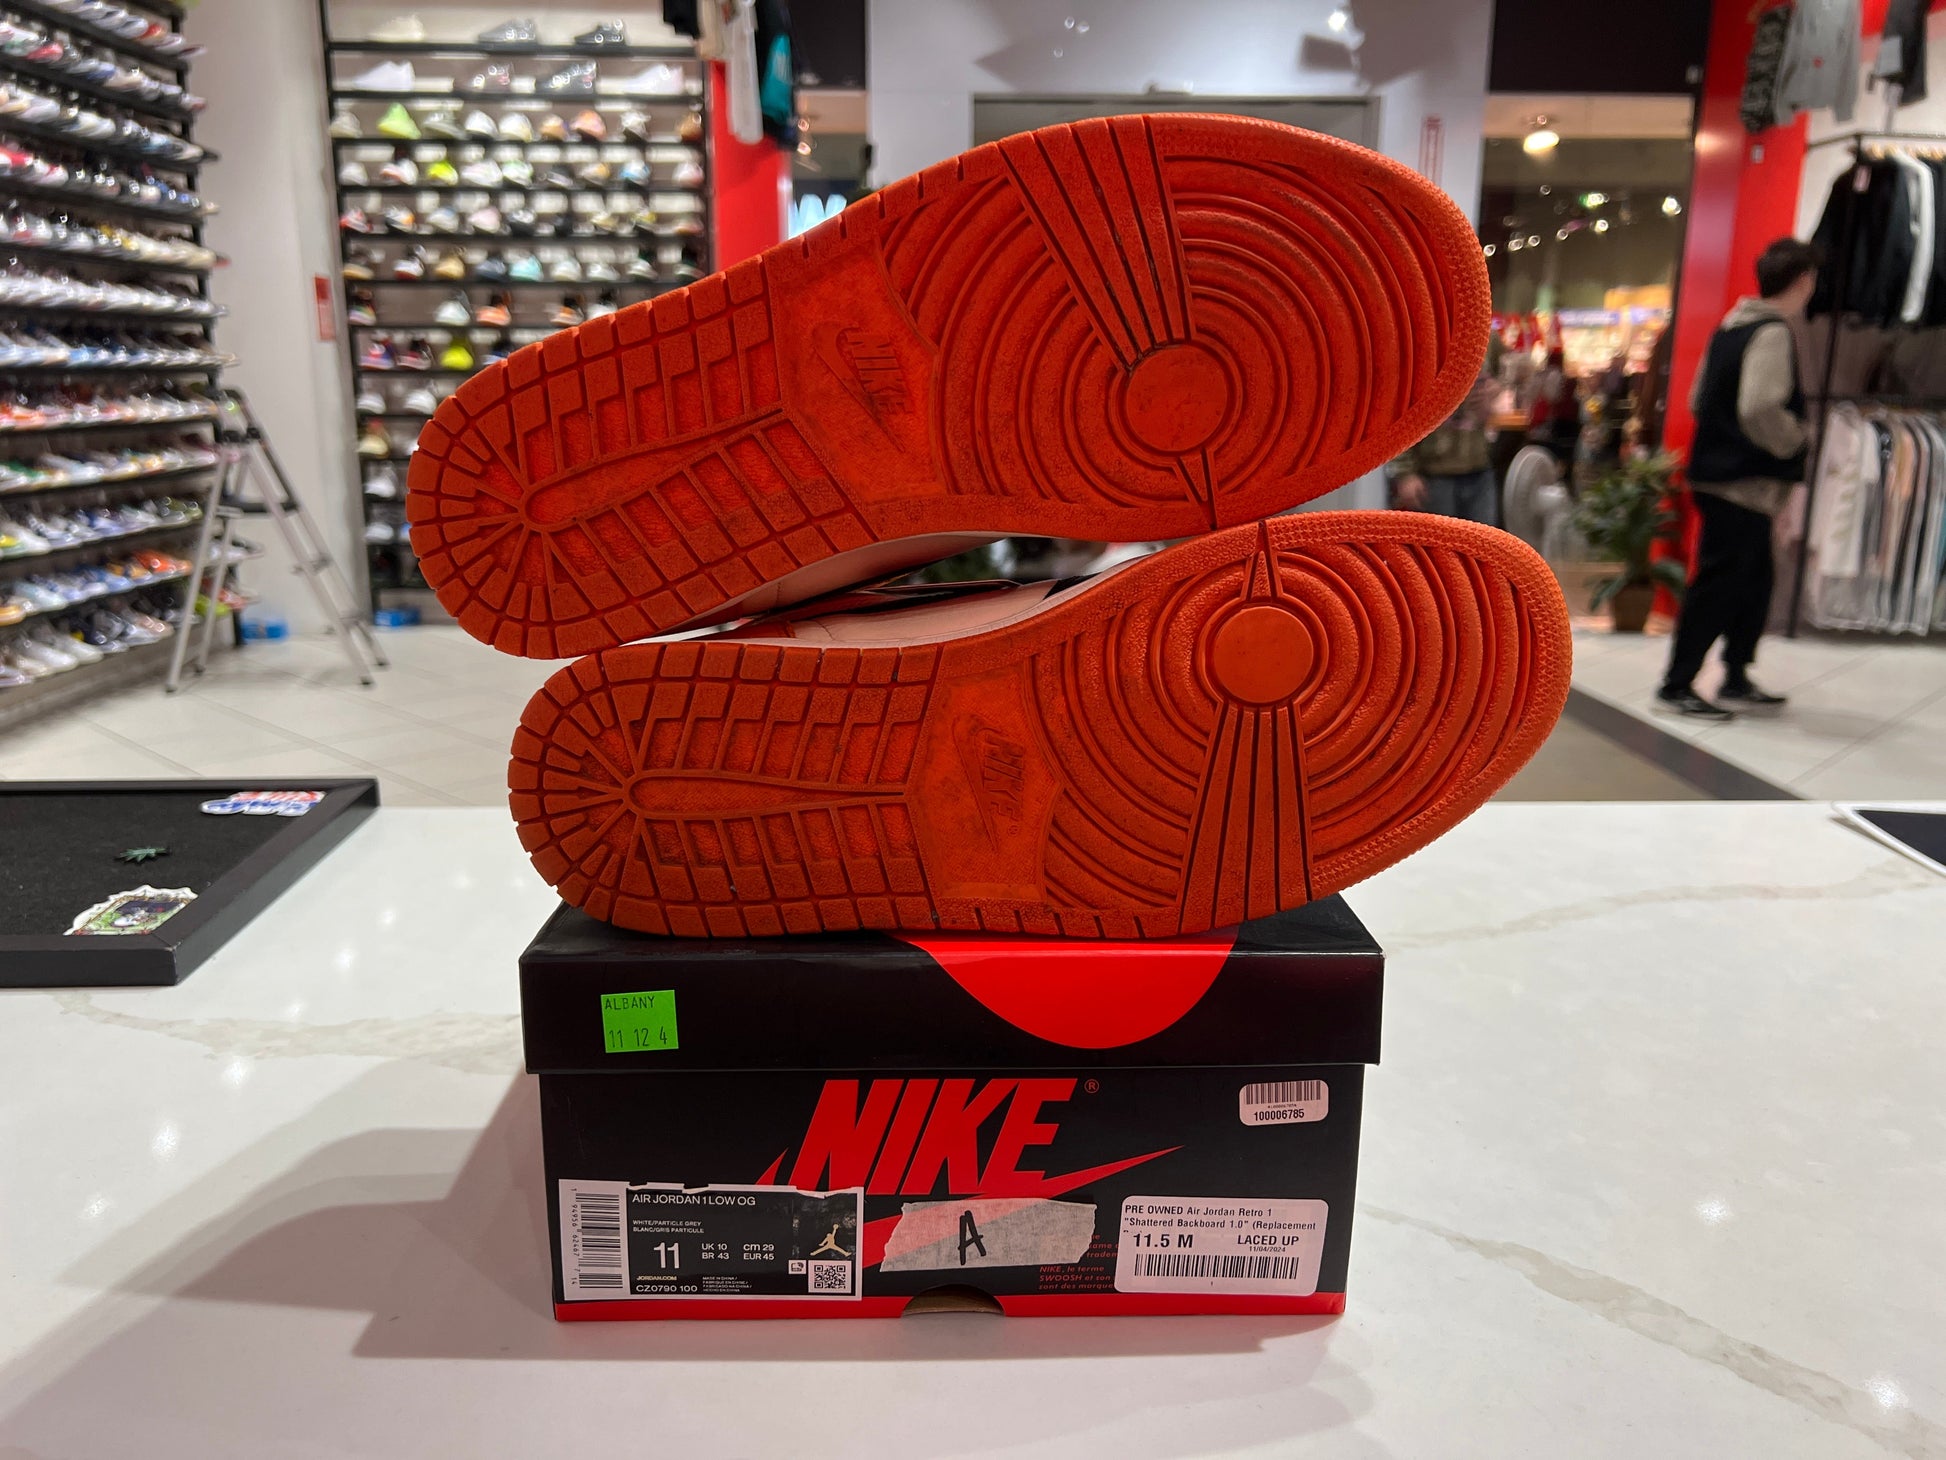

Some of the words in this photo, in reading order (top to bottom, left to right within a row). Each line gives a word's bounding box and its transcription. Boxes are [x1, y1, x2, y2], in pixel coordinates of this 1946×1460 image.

[848, 331, 907, 414] NIKE
[982, 734, 1025, 821] NIKE
[604, 995, 655, 1010] ALBANY
[609, 1029, 624, 1048] 11
[633, 1027, 650, 1047] 12
[659, 1026, 668, 1045] 4
[1254, 1108, 1305, 1121] 100006785
[787, 1078, 1078, 1196] NIKE
[632, 1194, 651, 1203] AIR
[652, 1194, 700, 1204] JORDAN
[702, 1196, 707, 1205] 1
[708, 1196, 736, 1205] LOW
[737, 1196, 756, 1206] OG
[1125, 1204, 1144, 1214] PRE
[1147, 1205, 1183, 1215] OWNED
[1187, 1206, 1200, 1215] Air
[1203, 1206, 1235, 1216] Jordan
[1238, 1207, 1263, 1217] Retro
[1267, 1208, 1272, 1217] 1
[1124, 1217, 1173, 1228] "Shattered
[1177, 1218, 1225, 1229] Backboard
[1229, 1220, 1249, 1229] 1.0"
[1252, 1221, 1316, 1231] (Replacement
[957, 1209, 988, 1266] A
[1133, 1233, 1170, 1248] 11.5
[1177, 1234, 1193, 1248] M
[1237, 1235, 1277, 1246] LACED
[1282, 1236, 1299, 1246] UP
[701, 1243, 715, 1251] UK
[717, 1243, 728, 1251] 10
[653, 1242, 680, 1269] 11
[701, 1252, 715, 1260] BR
[717, 1252, 729, 1260] 43
[1039, 1274, 1082, 1282] SWOOSH
